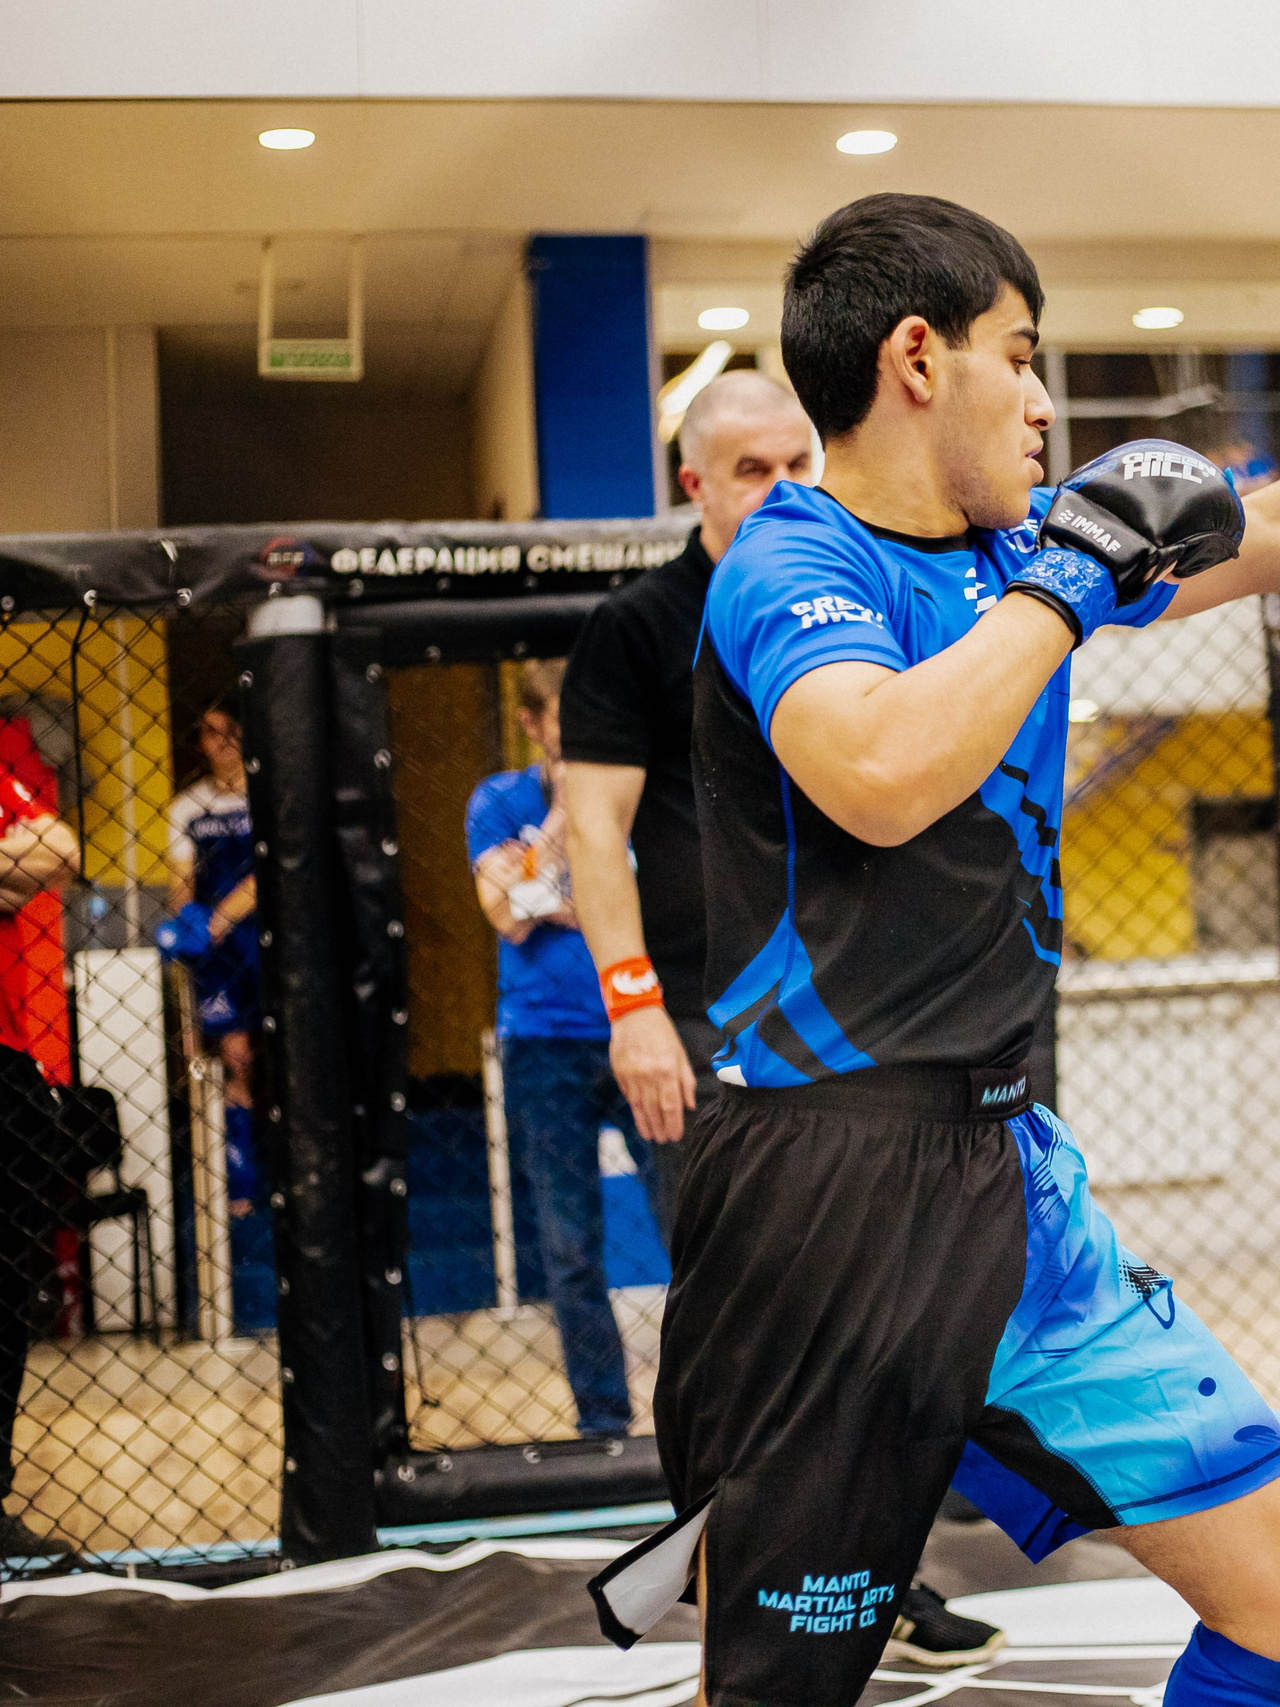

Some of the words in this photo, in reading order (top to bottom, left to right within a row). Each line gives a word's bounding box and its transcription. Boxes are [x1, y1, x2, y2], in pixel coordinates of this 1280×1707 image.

[1121, 451, 1217, 477] GREEN
[1124, 461, 1203, 484] HILL
[1070, 515, 1122, 553] IMMAF
[330, 545, 522, 577] ФЕДЕРАЦИЯ
[981, 1075, 1027, 1106] MANTO
[802, 1570, 871, 1594] MANTO
[757, 1589, 857, 1613] MARTIAL
[860, 1583, 895, 1609] ARTS
[789, 1613, 855, 1634] FIGHT
